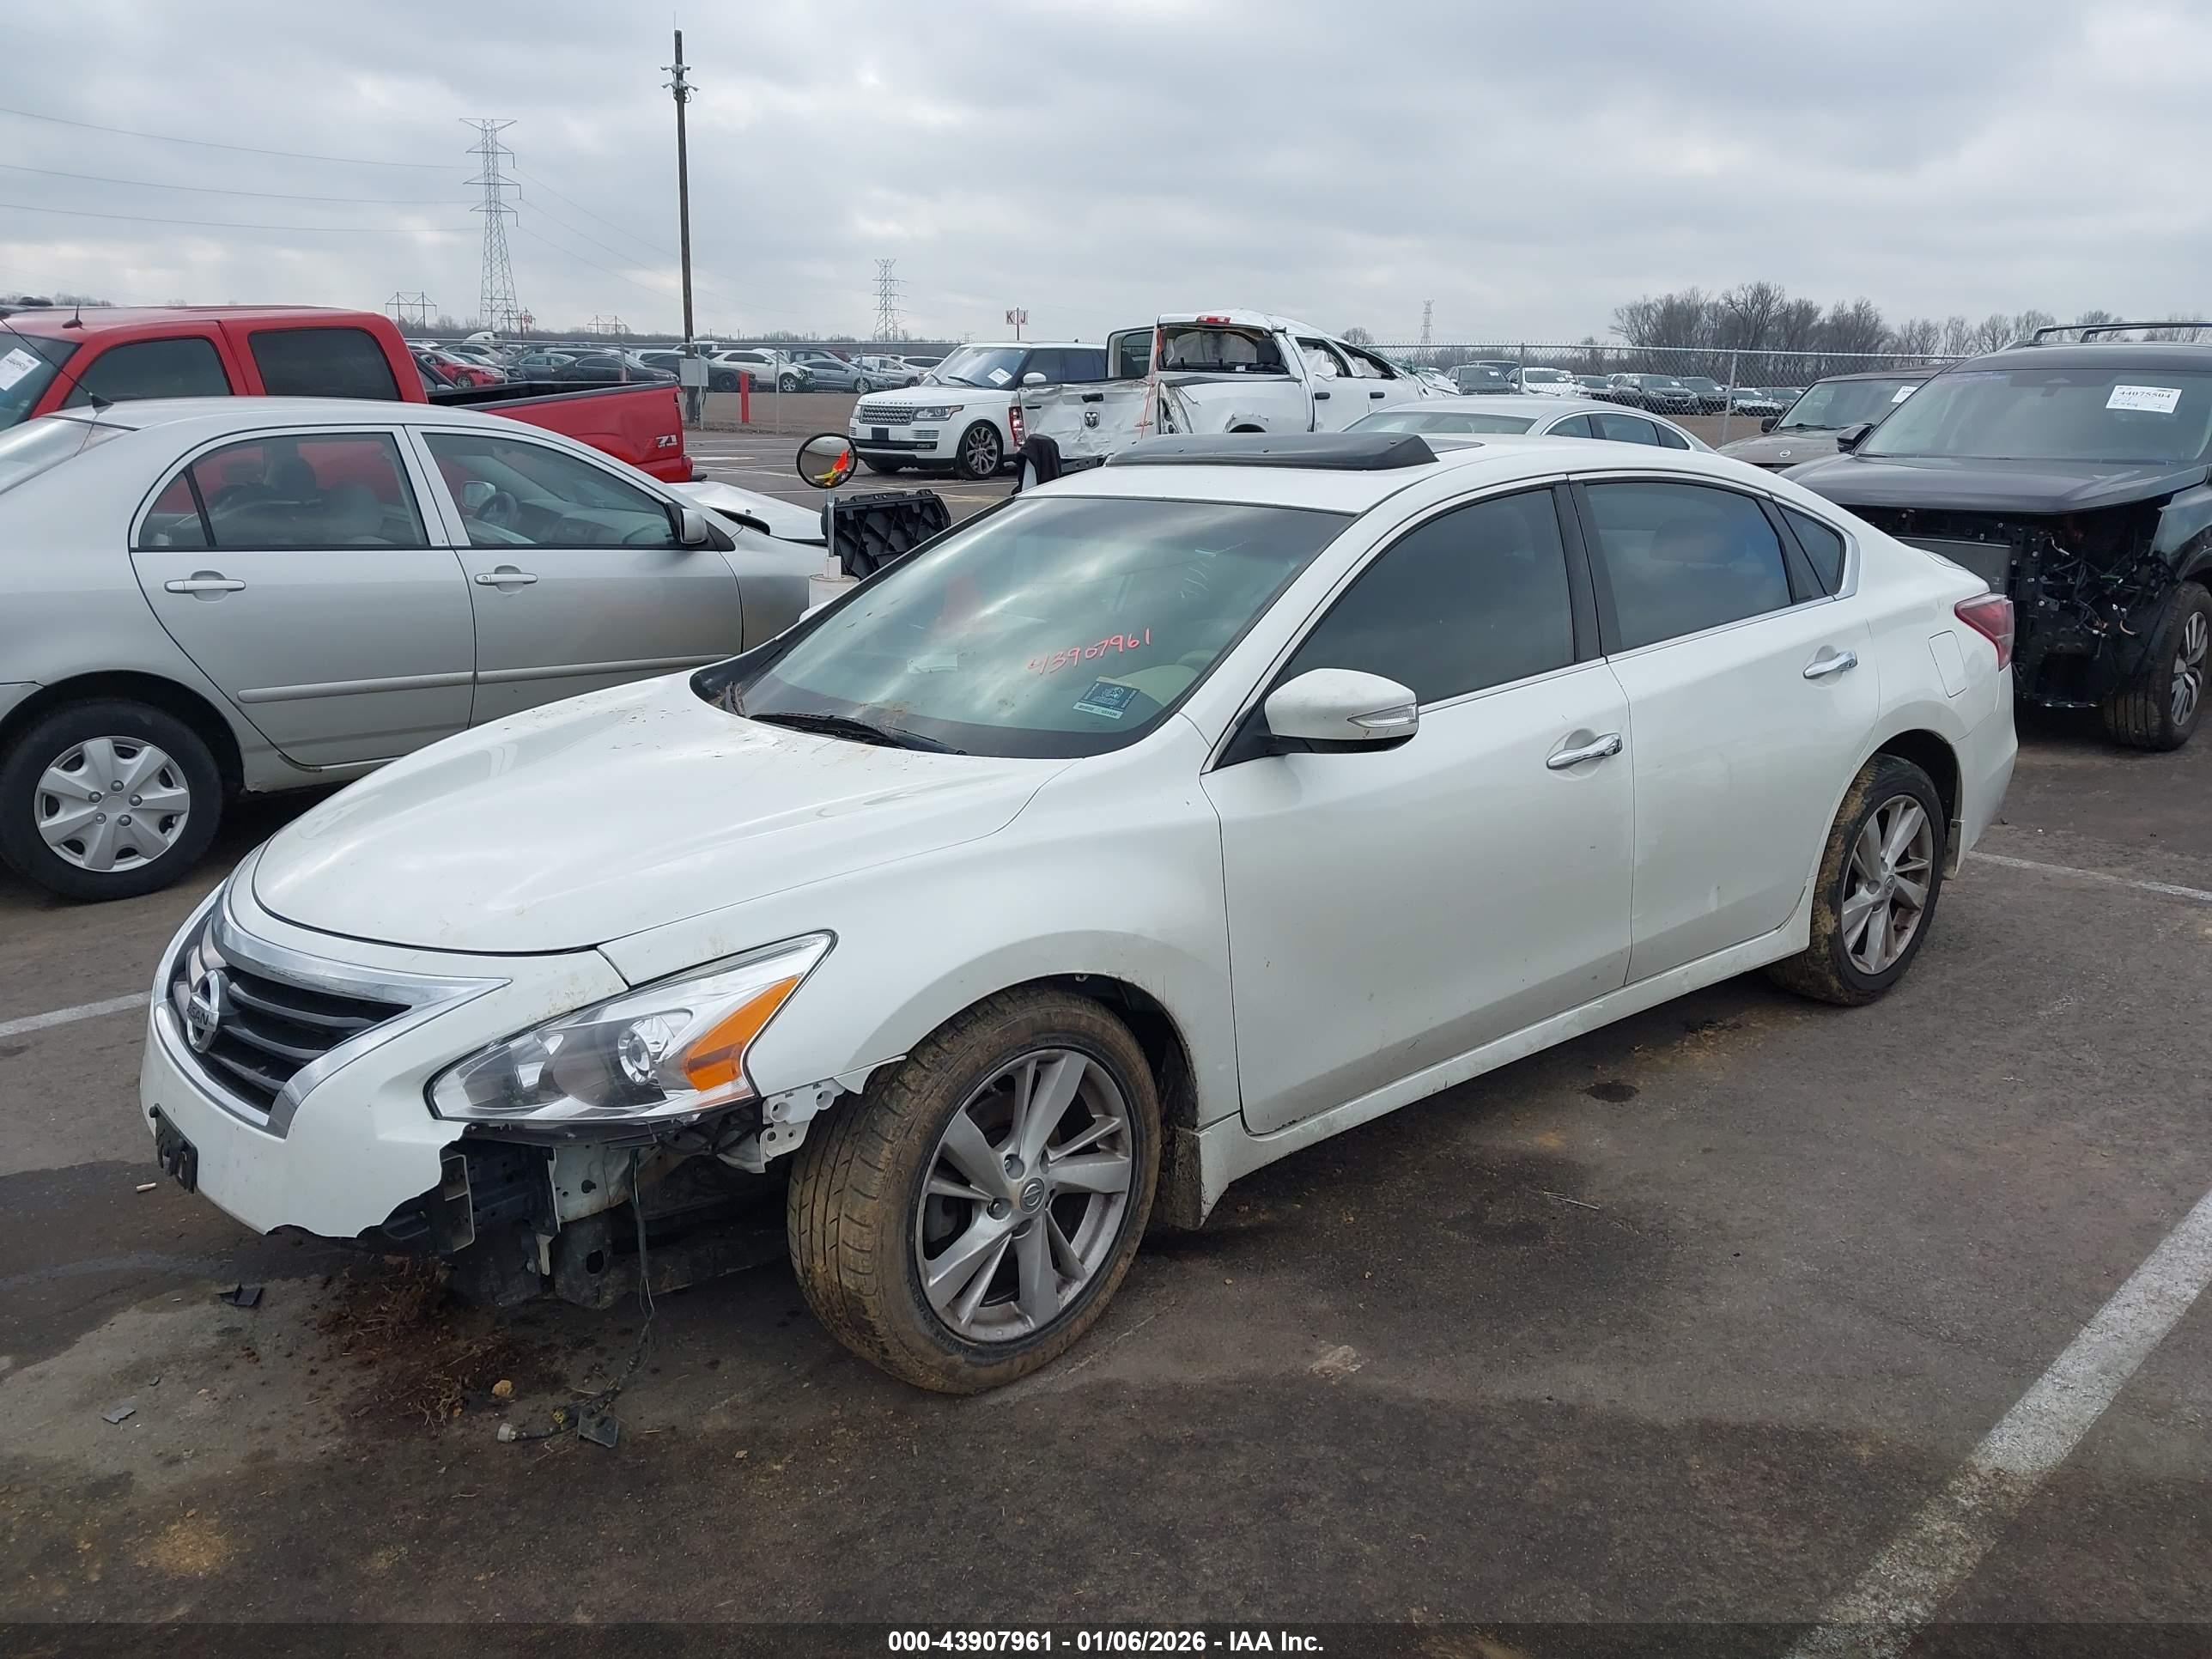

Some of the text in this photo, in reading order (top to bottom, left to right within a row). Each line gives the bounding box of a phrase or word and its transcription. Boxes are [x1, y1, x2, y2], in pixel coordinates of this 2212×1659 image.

[1006, 311, 1014, 324] K
[1020, 311, 1026, 324] J
[1026, 627, 1152, 674] 43907961
